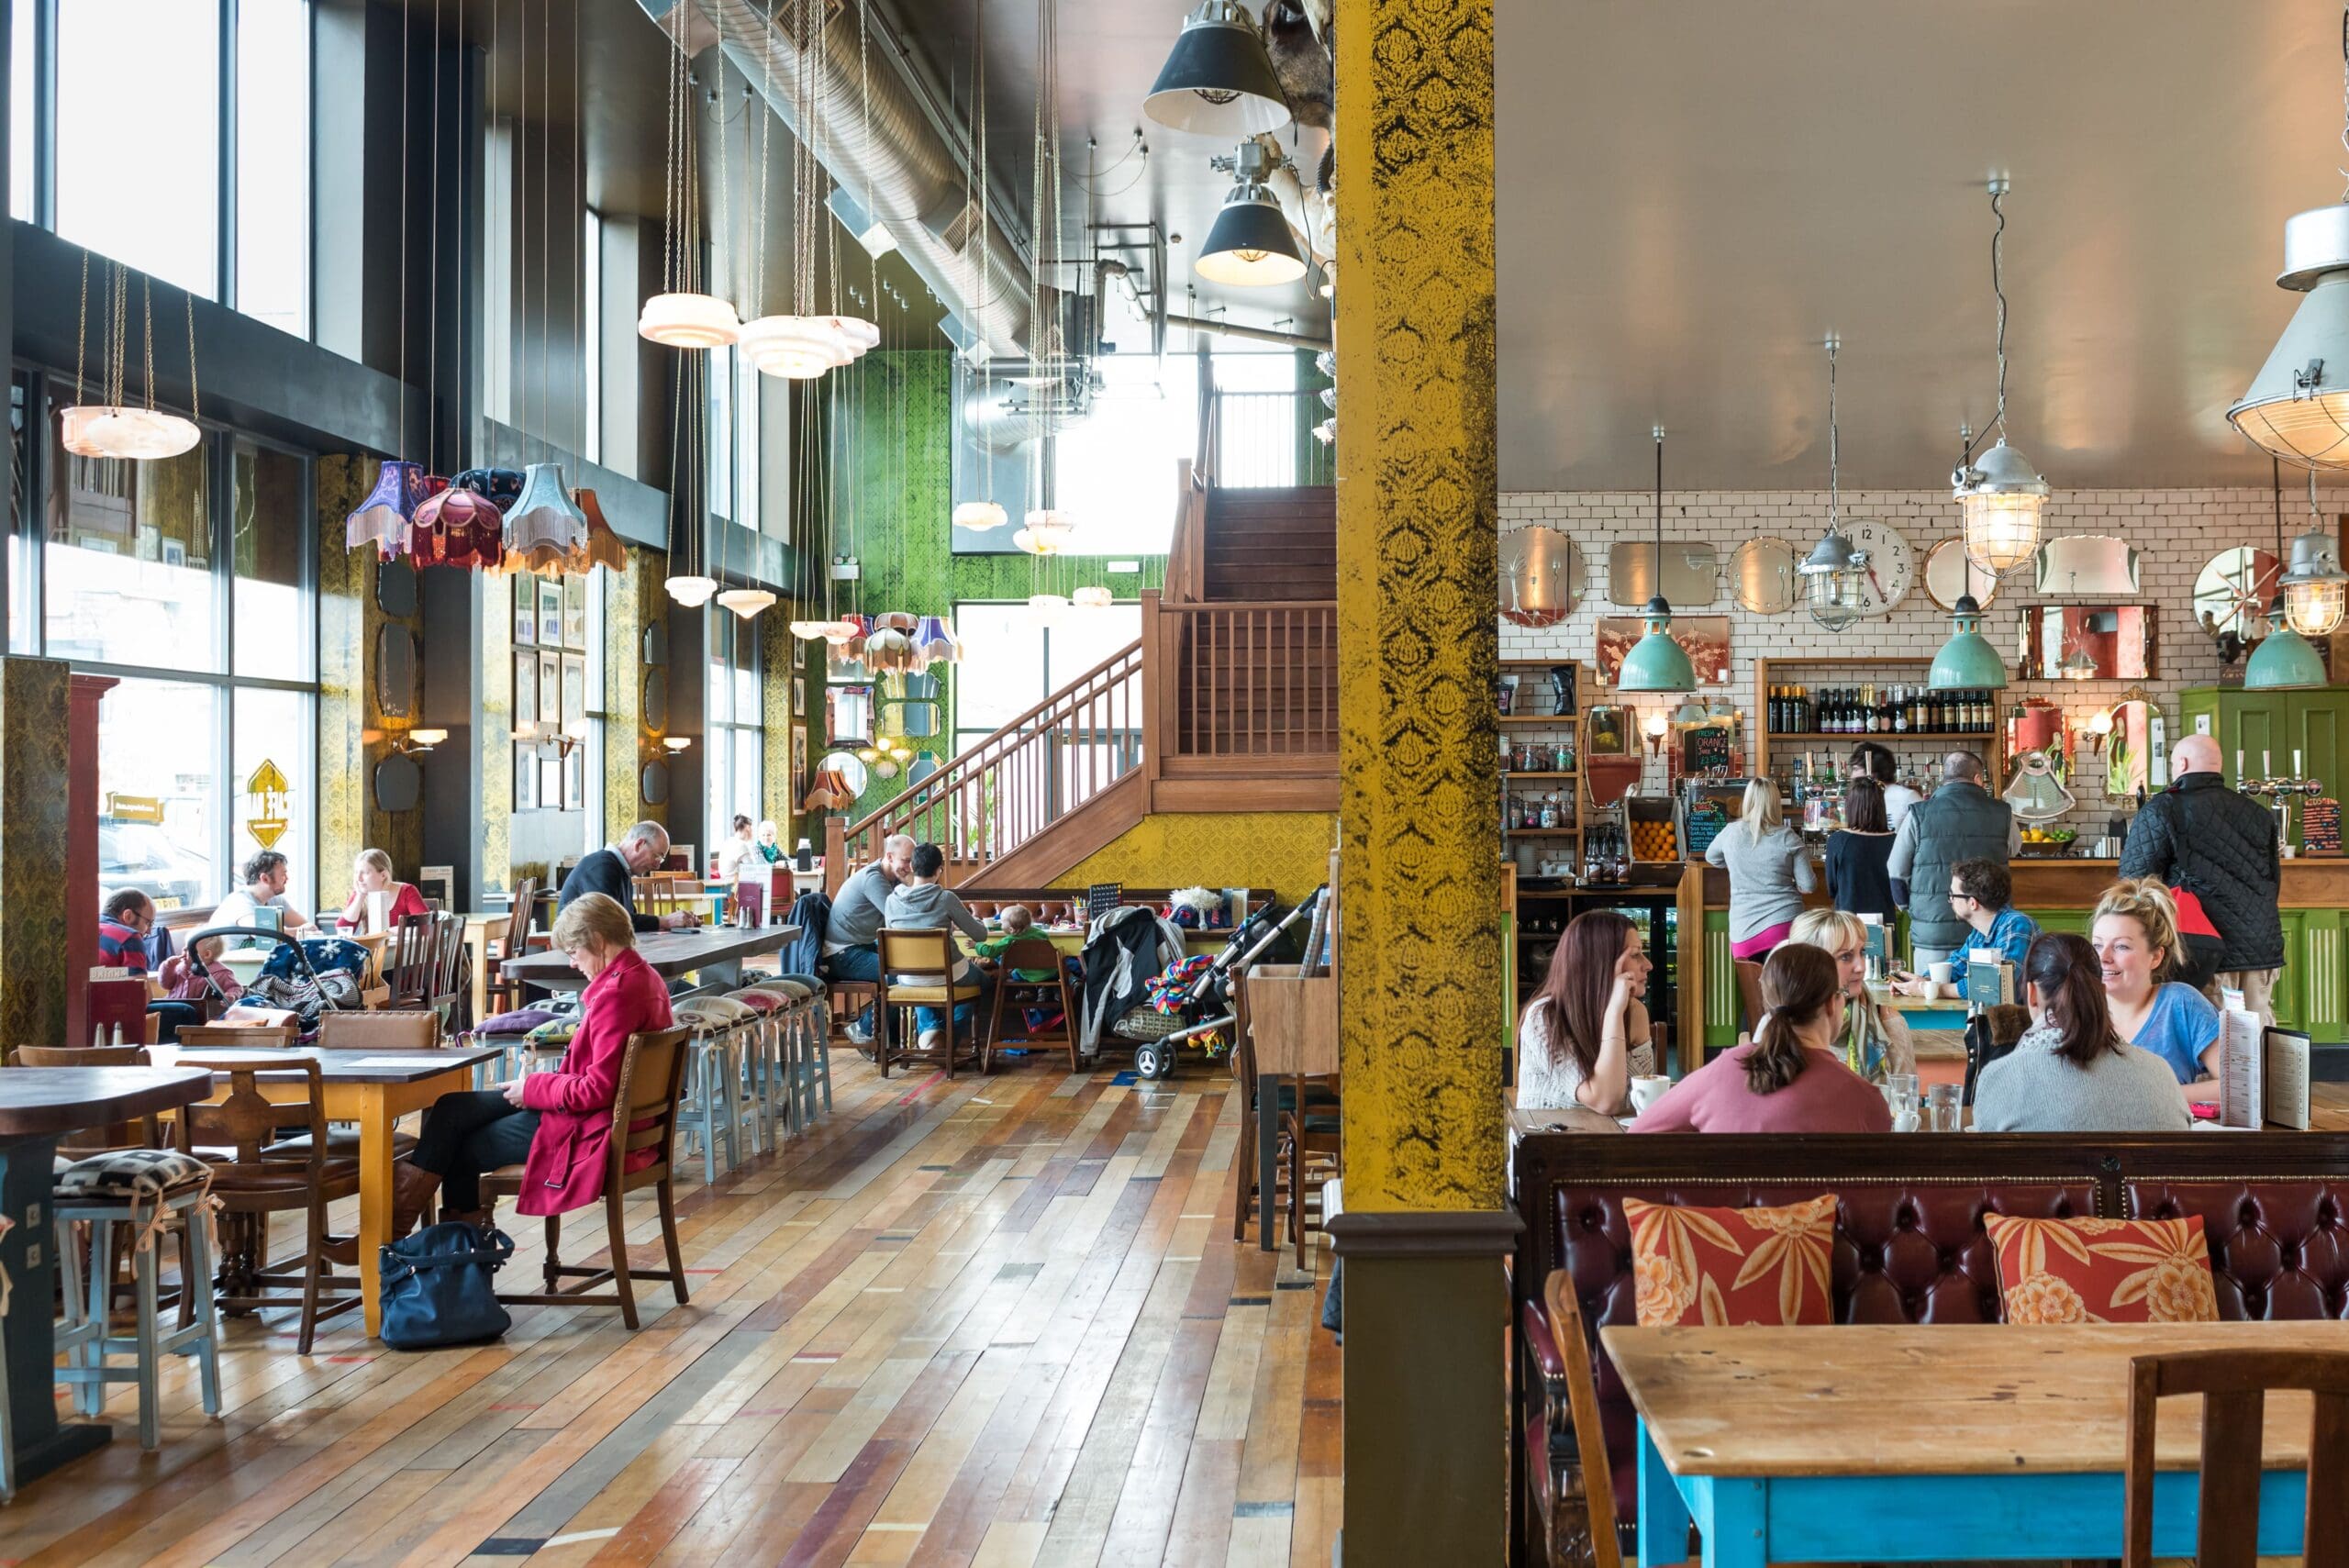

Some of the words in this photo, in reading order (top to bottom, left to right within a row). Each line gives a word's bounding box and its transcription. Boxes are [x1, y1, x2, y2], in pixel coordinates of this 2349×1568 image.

[1862, 529, 1872, 539] 12
[1893, 546, 1899, 556] 2
[1897, 563, 1904, 573] 3
[1863, 596, 1871, 607] 6
[1698, 738, 1728, 747] ORANGE
